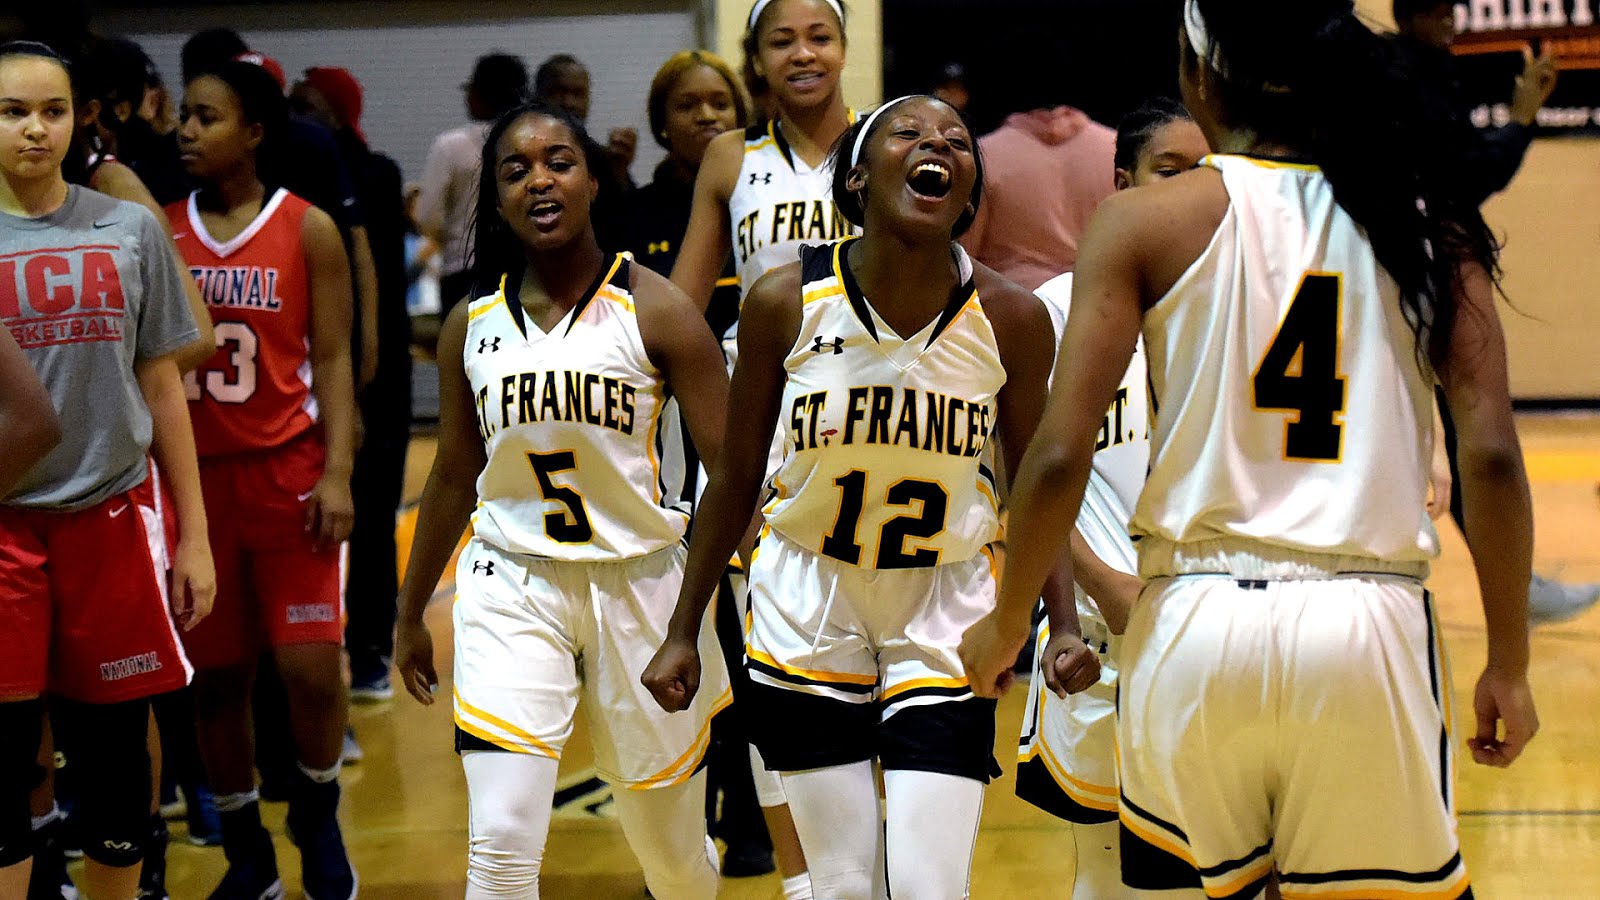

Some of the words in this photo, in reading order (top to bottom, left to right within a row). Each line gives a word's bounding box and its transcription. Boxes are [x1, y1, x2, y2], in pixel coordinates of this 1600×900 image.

[738, 208, 763, 263] ST.
[771, 200, 853, 244] FRAN
[501, 370, 637, 436] FRANCES
[1251, 270, 1349, 463] 4
[790, 389, 829, 452] ST.
[841, 384, 989, 459] FRANCES
[525, 448, 596, 546] 5
[819, 467, 950, 570] 12
[100, 651, 162, 681] NATIONAL
